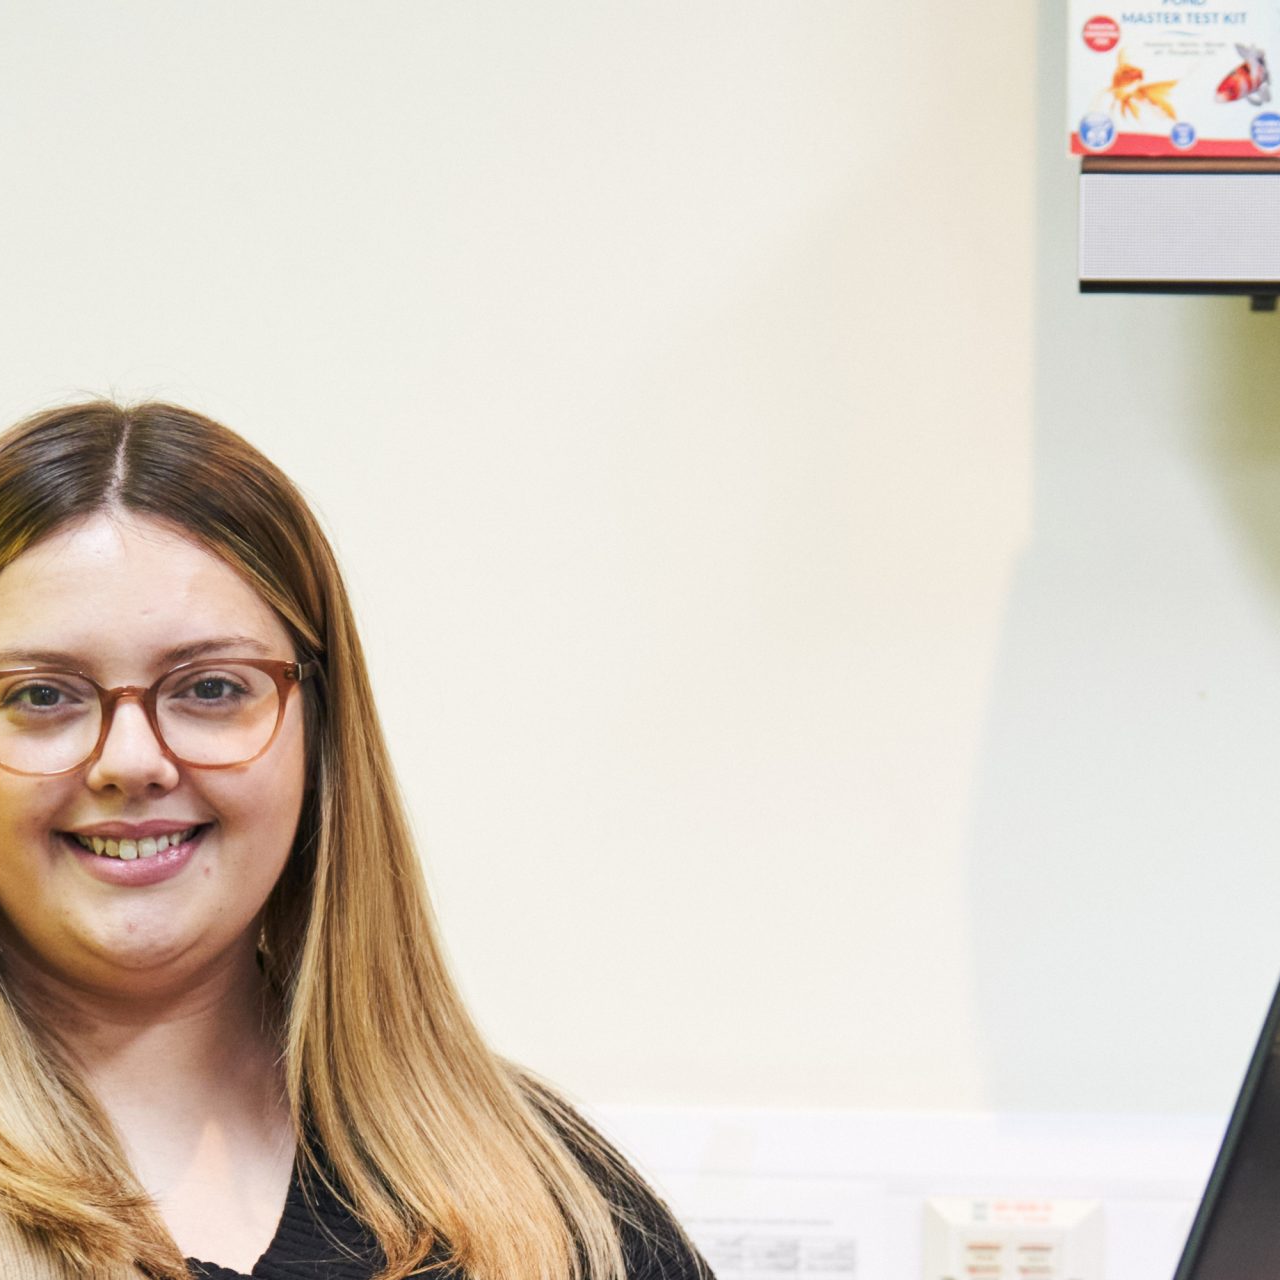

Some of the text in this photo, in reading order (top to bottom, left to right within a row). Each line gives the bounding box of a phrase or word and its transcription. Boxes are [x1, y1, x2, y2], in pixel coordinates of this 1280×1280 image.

[1121, 11, 1248, 24] MASTER TEST KIT
